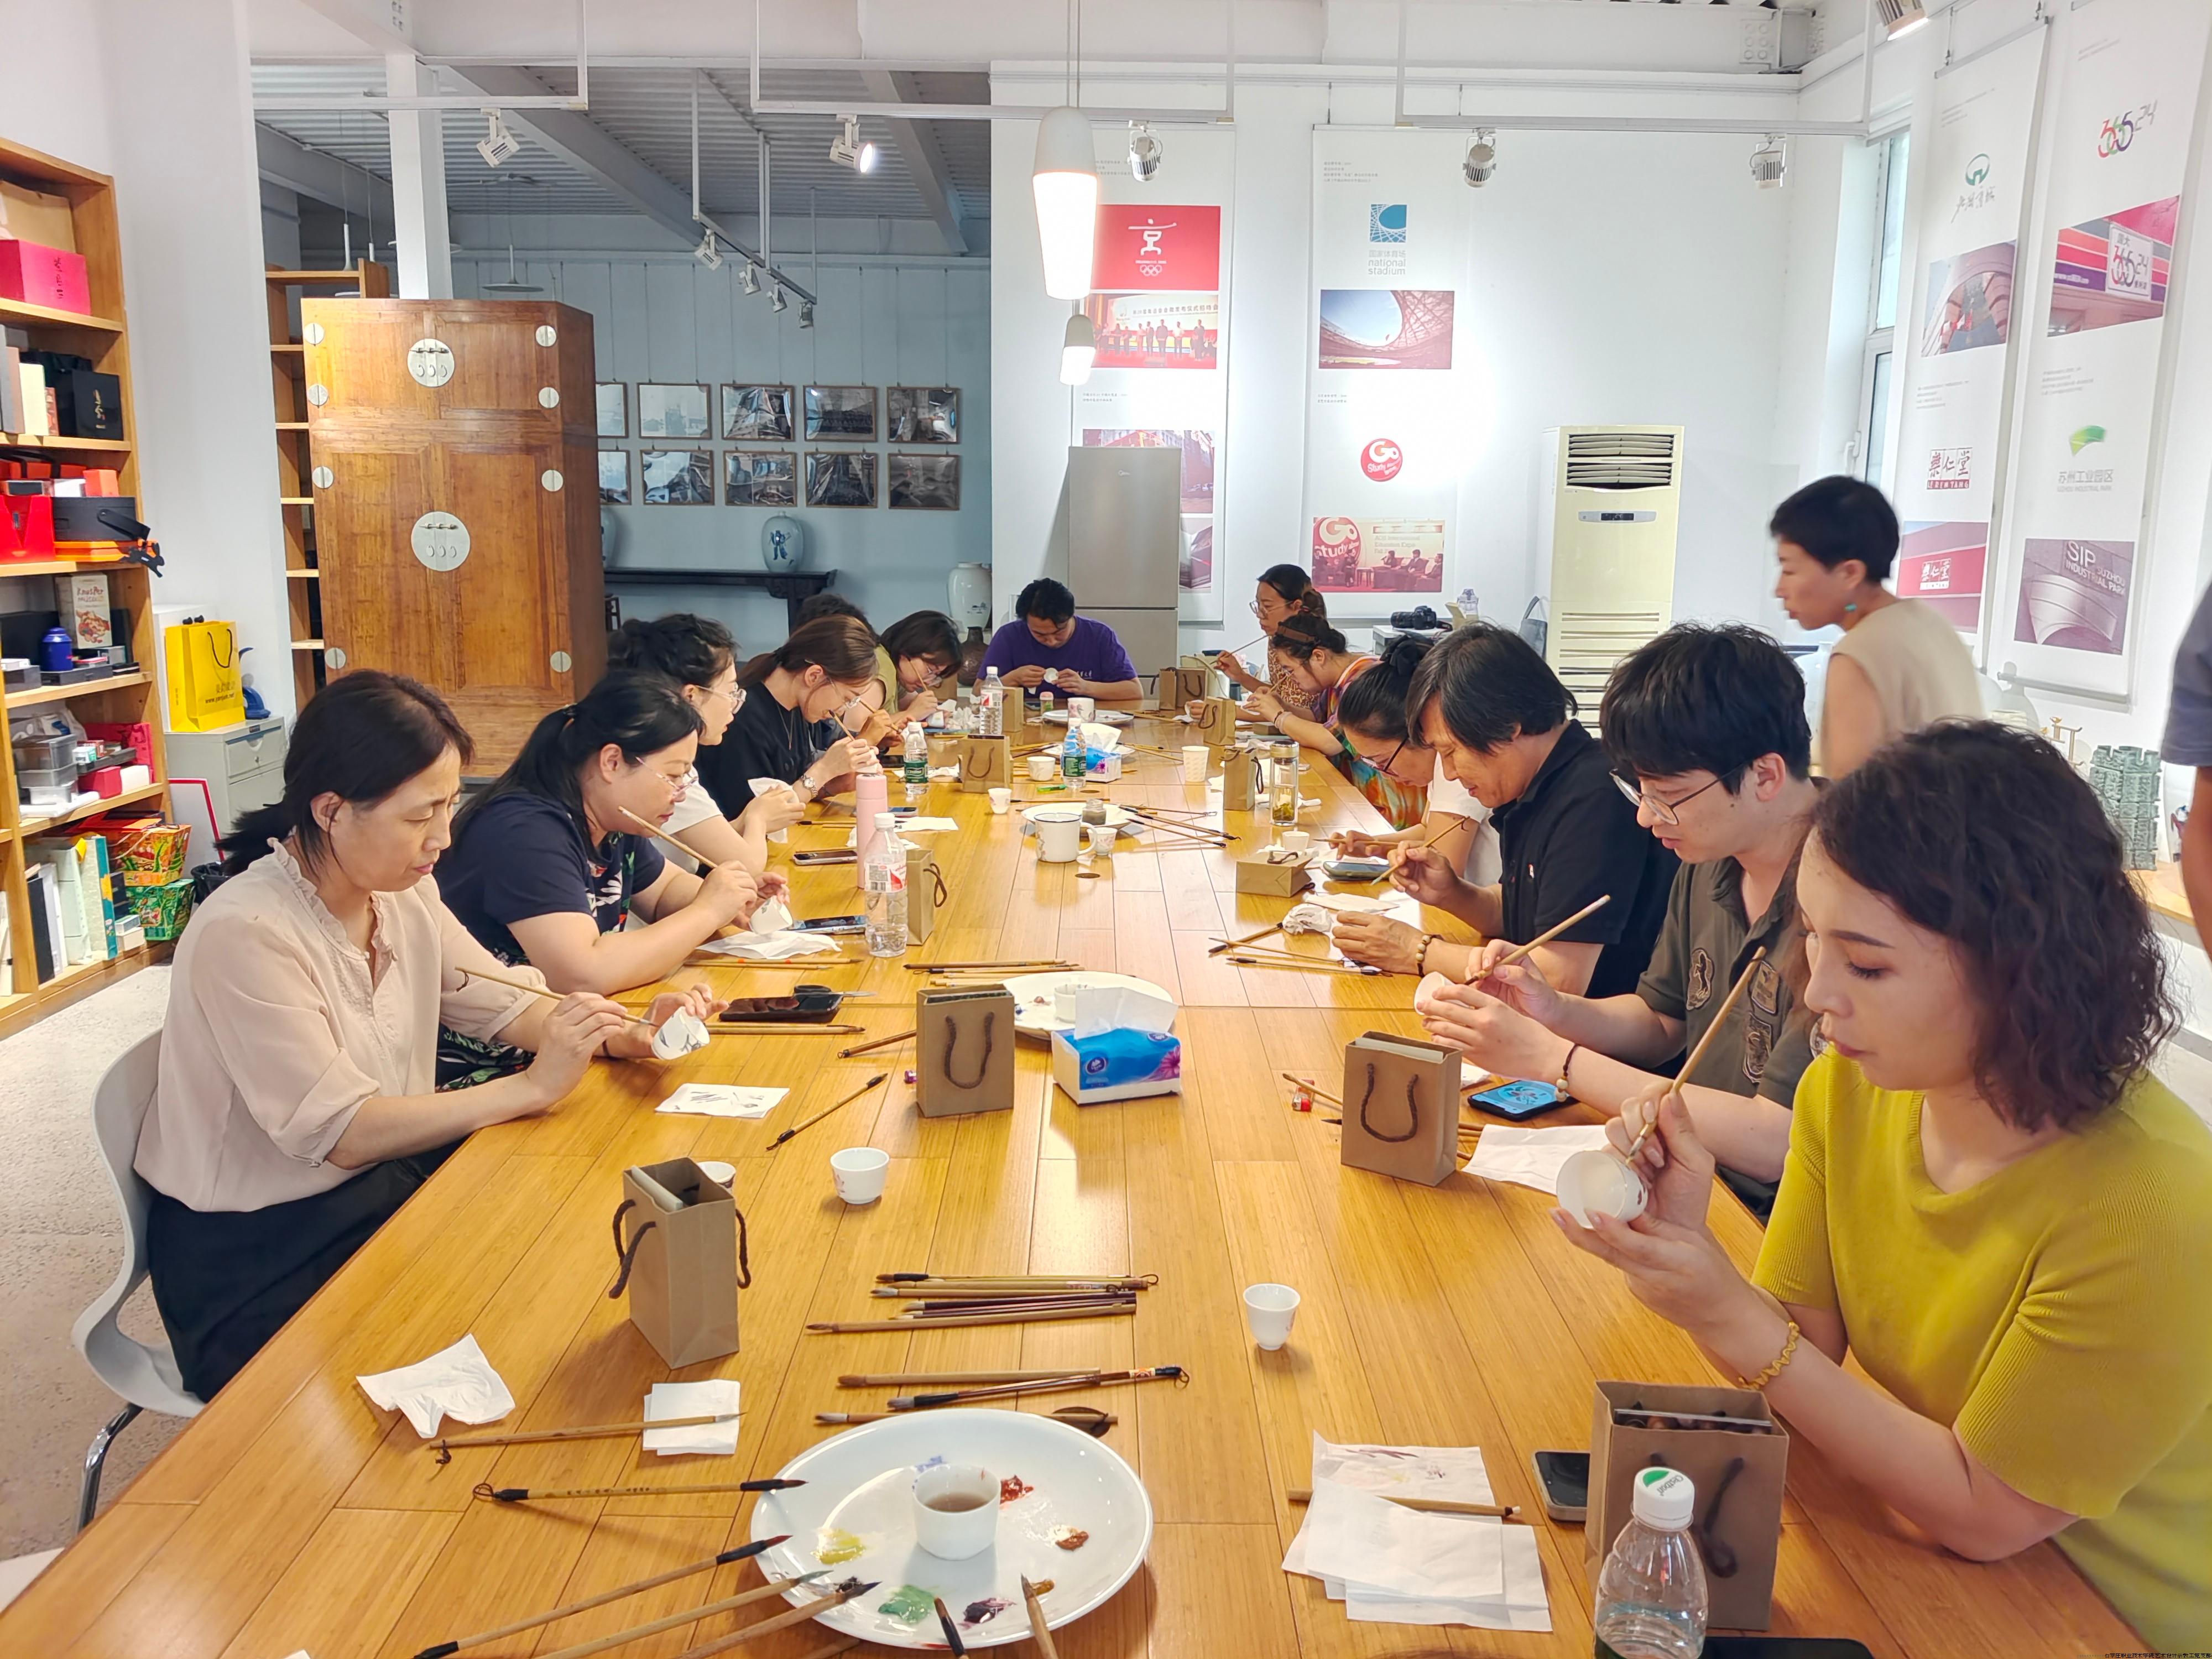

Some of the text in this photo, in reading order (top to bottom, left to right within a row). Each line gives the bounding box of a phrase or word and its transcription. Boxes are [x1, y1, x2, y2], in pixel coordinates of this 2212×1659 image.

[1368, 258, 1406, 267] national
[1369, 249, 1406, 258] 国家体育场
[1368, 266, 1405, 275] stadium
[1369, 441, 1400, 463] Go
[2058, 469, 2114, 483] 苏州工业园区
[1319, 518, 1358, 545] Go
[2067, 540, 2096, 567] SIP
[2065, 559, 2108, 588] INDUSTRIAL
[2096, 566, 2126, 587] SUZHOU
